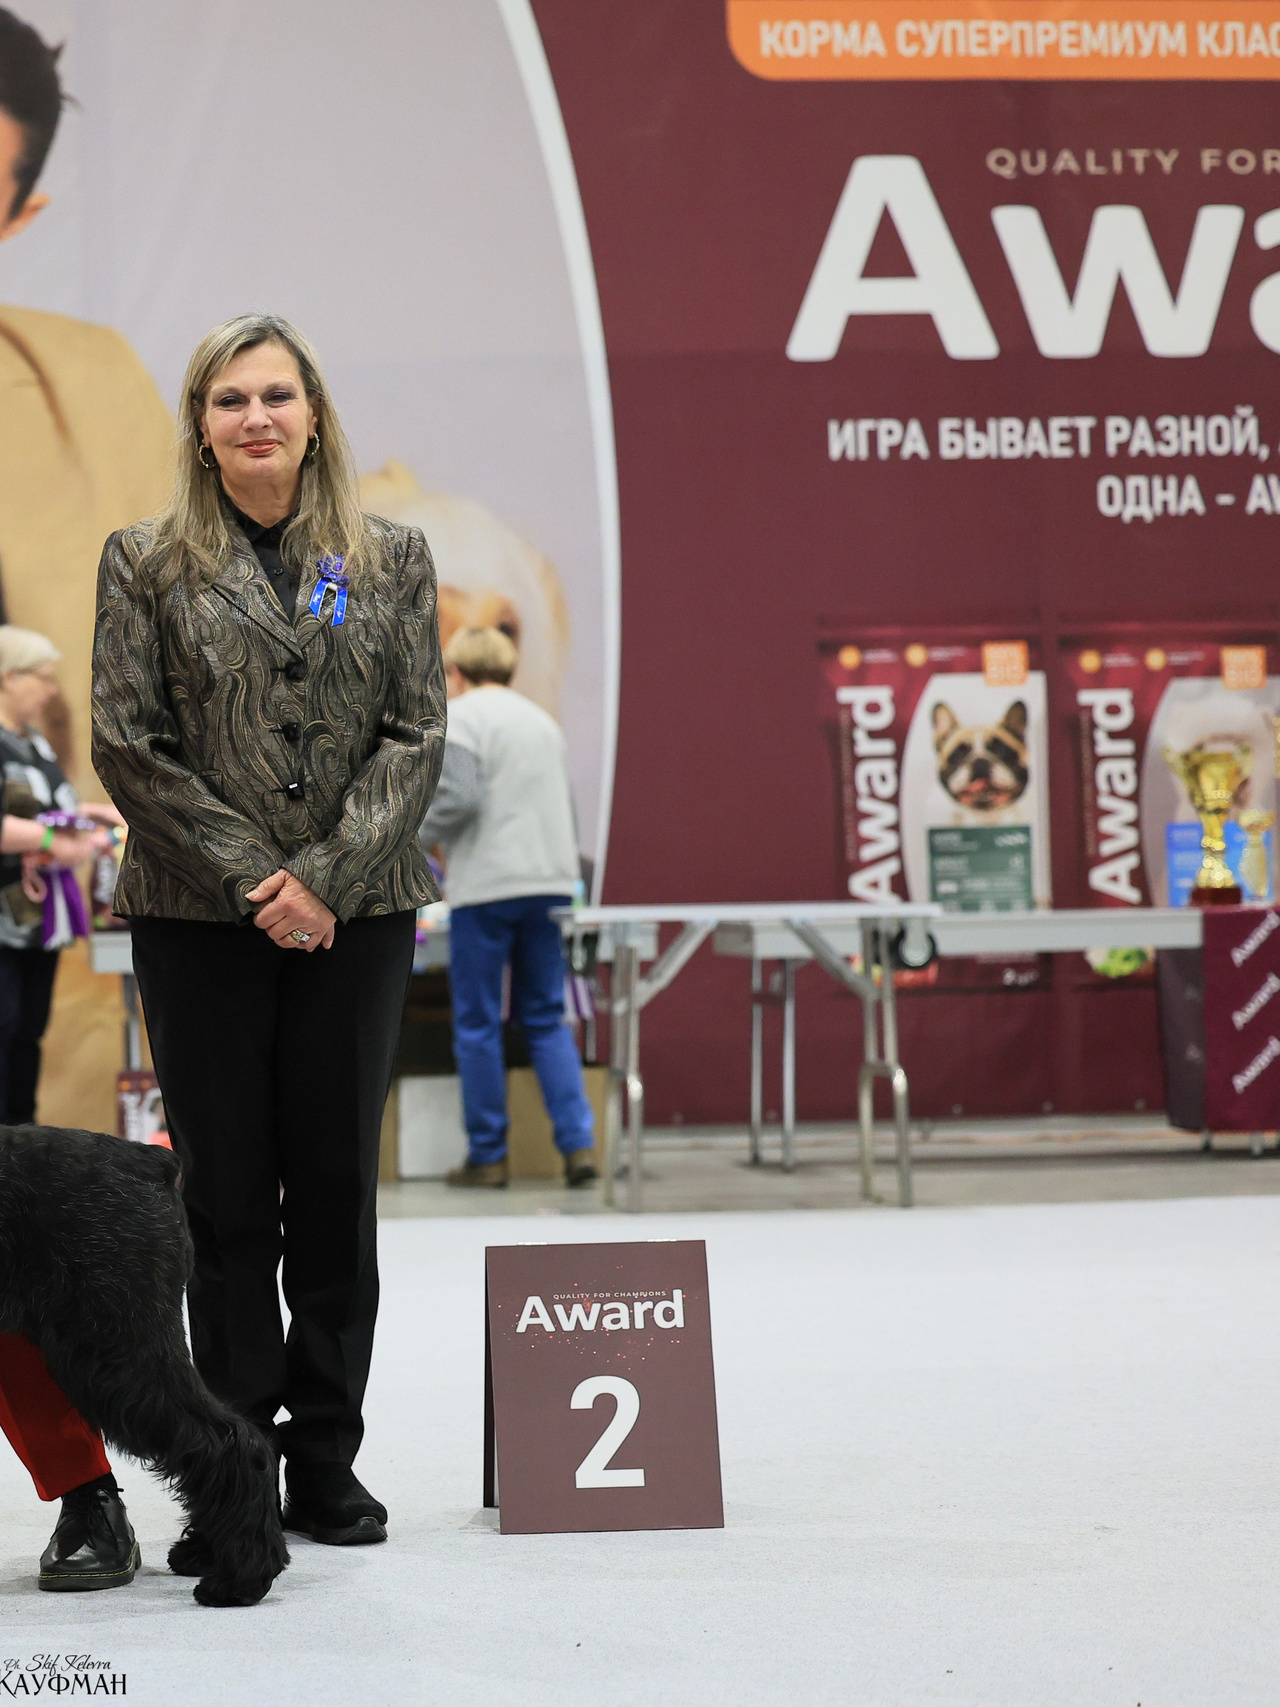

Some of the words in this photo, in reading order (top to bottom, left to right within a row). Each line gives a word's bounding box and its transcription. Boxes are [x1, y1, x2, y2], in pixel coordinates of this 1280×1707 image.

[759, 21, 887, 59] КОРМА
[895, 20, 1188, 59] СУПЕРПРЕМИУМ
[986, 148, 1180, 179] QUALITY
[785, 154, 1280, 362] Aw
[828, 417, 929, 461] ИГРА
[938, 415, 1097, 460] БЫВАЕТ
[1105, 404, 1270, 462] РАЗНОЙ,
[1096, 473, 1207, 523] ОДНА
[836, 685, 903, 903] Award
[1076, 688, 1143, 905] Award
[516, 1289, 685, 1333] Award
[613, 1290, 667, 1298] CHAMPIONS
[570, 1375, 646, 1489] 2
